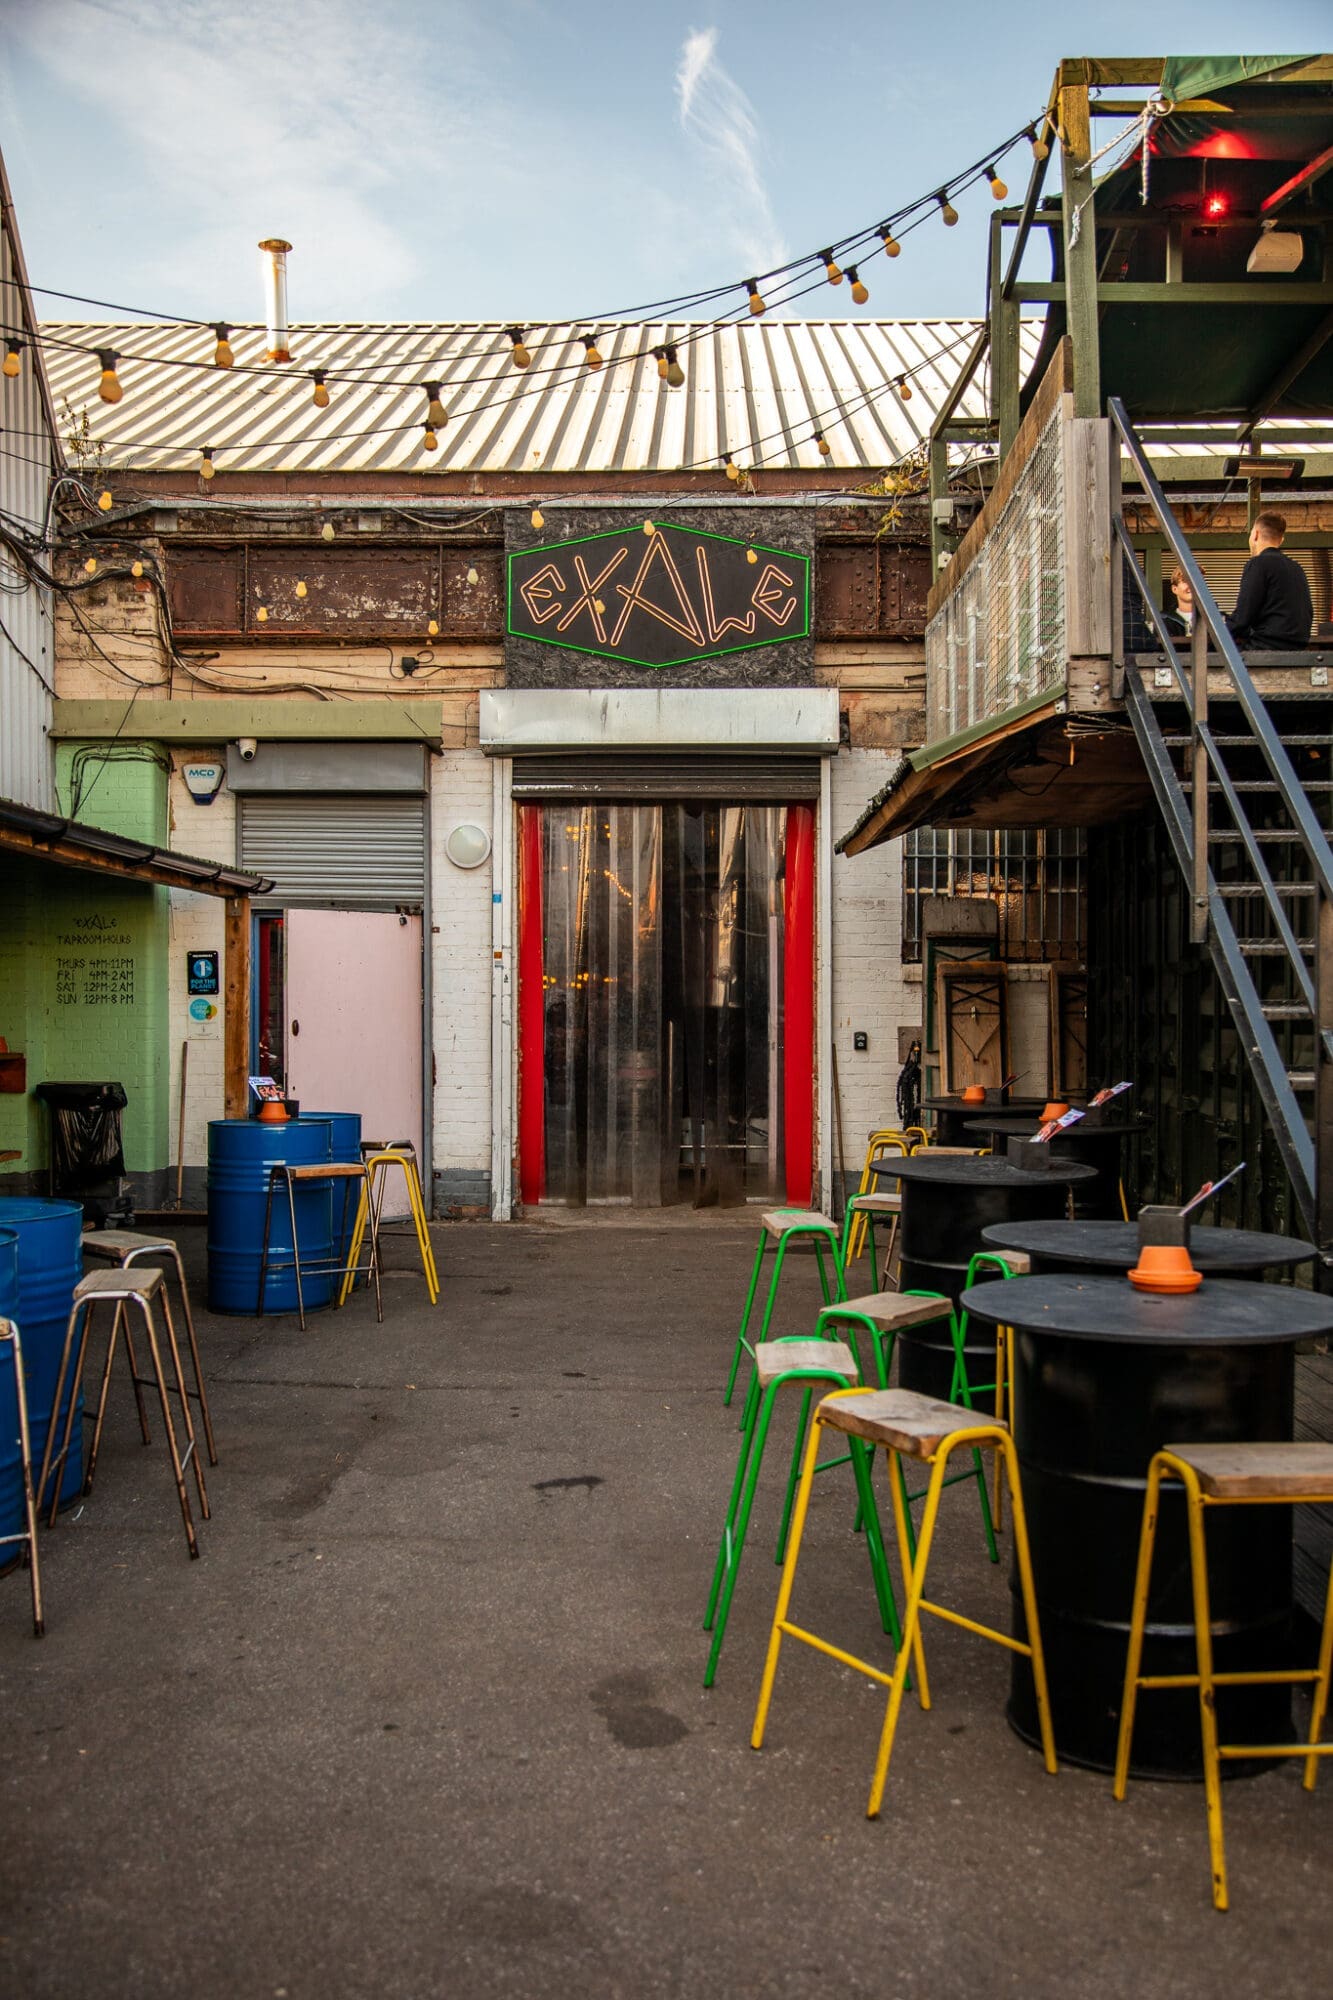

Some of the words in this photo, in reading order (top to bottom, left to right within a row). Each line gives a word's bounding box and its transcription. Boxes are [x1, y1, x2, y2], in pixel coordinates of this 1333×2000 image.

[520, 531, 796, 646] EXALE
[188, 769, 215, 777] MCD
[57, 935, 102, 945] TAPROOM
[56, 958, 86, 969] THURS
[56, 982, 76, 993] SAT
[56, 993, 77, 1005] SUN
